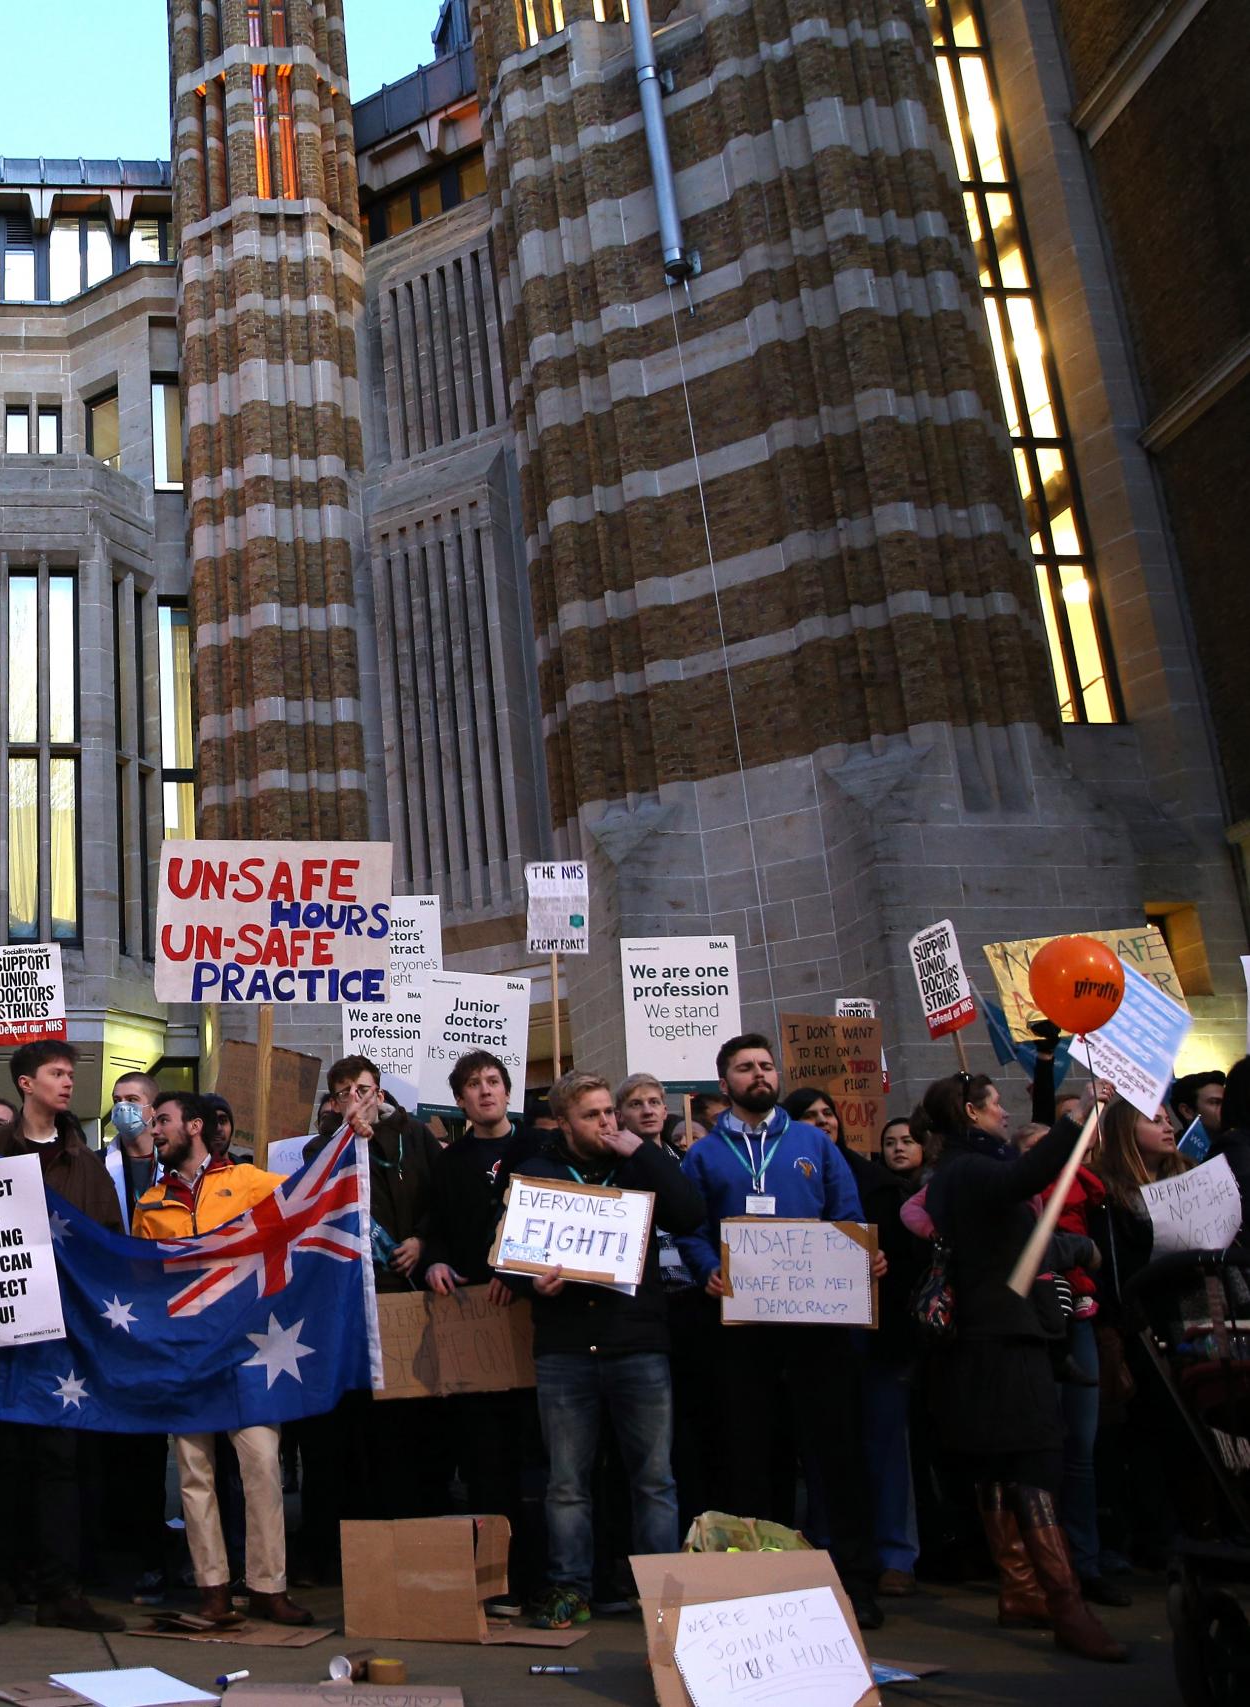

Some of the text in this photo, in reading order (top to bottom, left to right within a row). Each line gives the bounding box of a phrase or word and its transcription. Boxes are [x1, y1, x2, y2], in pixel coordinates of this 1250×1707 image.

[168, 858, 360, 903] UN-SAFE
[531, 865, 583, 879] THE NHS
[270, 901, 389, 939] HOURS
[391, 918, 415, 928] nior
[161, 924, 335, 967] UN-SAFE
[531, 939, 558, 951] FIGHT
[630, 965, 728, 978] We are one
[191, 962, 385, 1002] PRACTICE
[1074, 978, 1119, 1002] giraffe
[633, 982, 728, 1001] profession
[453, 998, 500, 1013] Junior
[644, 1003, 719, 1018] We stand
[929, 999, 973, 1028] Defend NHS
[348, 1009, 421, 1023] We are one
[445, 1013, 507, 1029] doctors'
[30, 1024, 43, 1032] our
[46, 1020, 62, 1031] NHS
[350, 1026, 420, 1040] profession
[649, 1022, 718, 1040] together
[788, 1024, 874, 1043] I DON'T WANT
[443, 1032, 507, 1046] contract
[358, 1044, 413, 1058] We stand
[428, 1046, 444, 1058] It's
[798, 1046, 861, 1059] TO FLY ON A
[789, 1065, 816, 1080] PLANE
[840, 1065, 847, 1073] A
[1093, 1061, 1134, 1093] ADD UP!
[519, 1190, 628, 1217] EVERYONE'S
[522, 1218, 628, 1262] FIGHT!
[725, 1229, 816, 1256] UNSAFE
[0, 1252, 32, 1273] CAN
[771, 1259, 812, 1271] YOU!
[788, 1277, 815, 1289] FOR
[754, 1297, 848, 1315] DEMOCRACY?
[686, 1598, 813, 1633] WE'RE NOT
[707, 1624, 799, 1660] JOINING
[791, 1637, 852, 1667] HUNT
